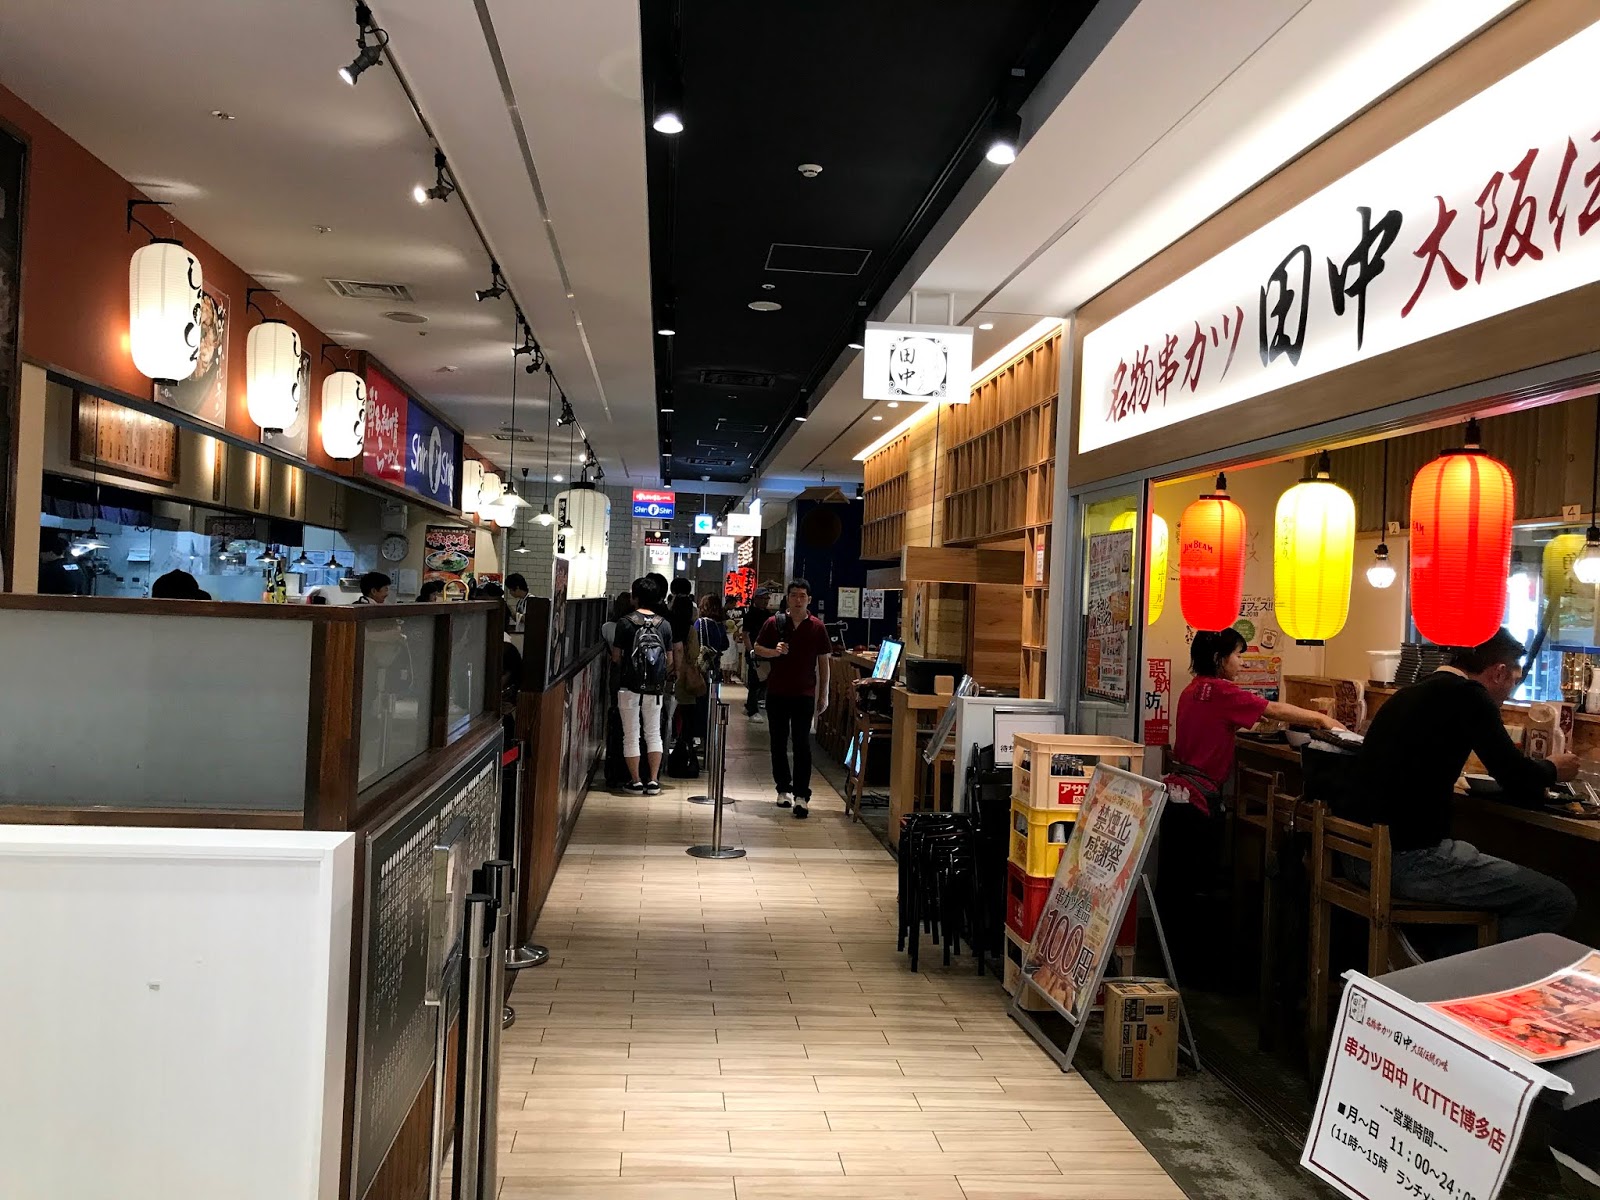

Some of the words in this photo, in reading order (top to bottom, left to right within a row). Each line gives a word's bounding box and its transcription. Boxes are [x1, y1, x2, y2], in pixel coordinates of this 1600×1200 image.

[898, 347, 916, 387] 田中
[411, 433, 429, 475] Shin
[1391, 522, 1397, 534] 2
[1568, 506, 1577, 520] 4
[1193, 540, 1213, 554] BEAM
[1094, 804, 1132, 843] 禁煙化
[1084, 836, 1123, 873] 感謝祭
[1055, 887, 1093, 924] 串カツ全品
[1039, 909, 1095, 987] 100円
[1344, 1036, 1408, 1090] 串カツ田中
[1412, 1077, 1507, 1155] KITTE博多店
